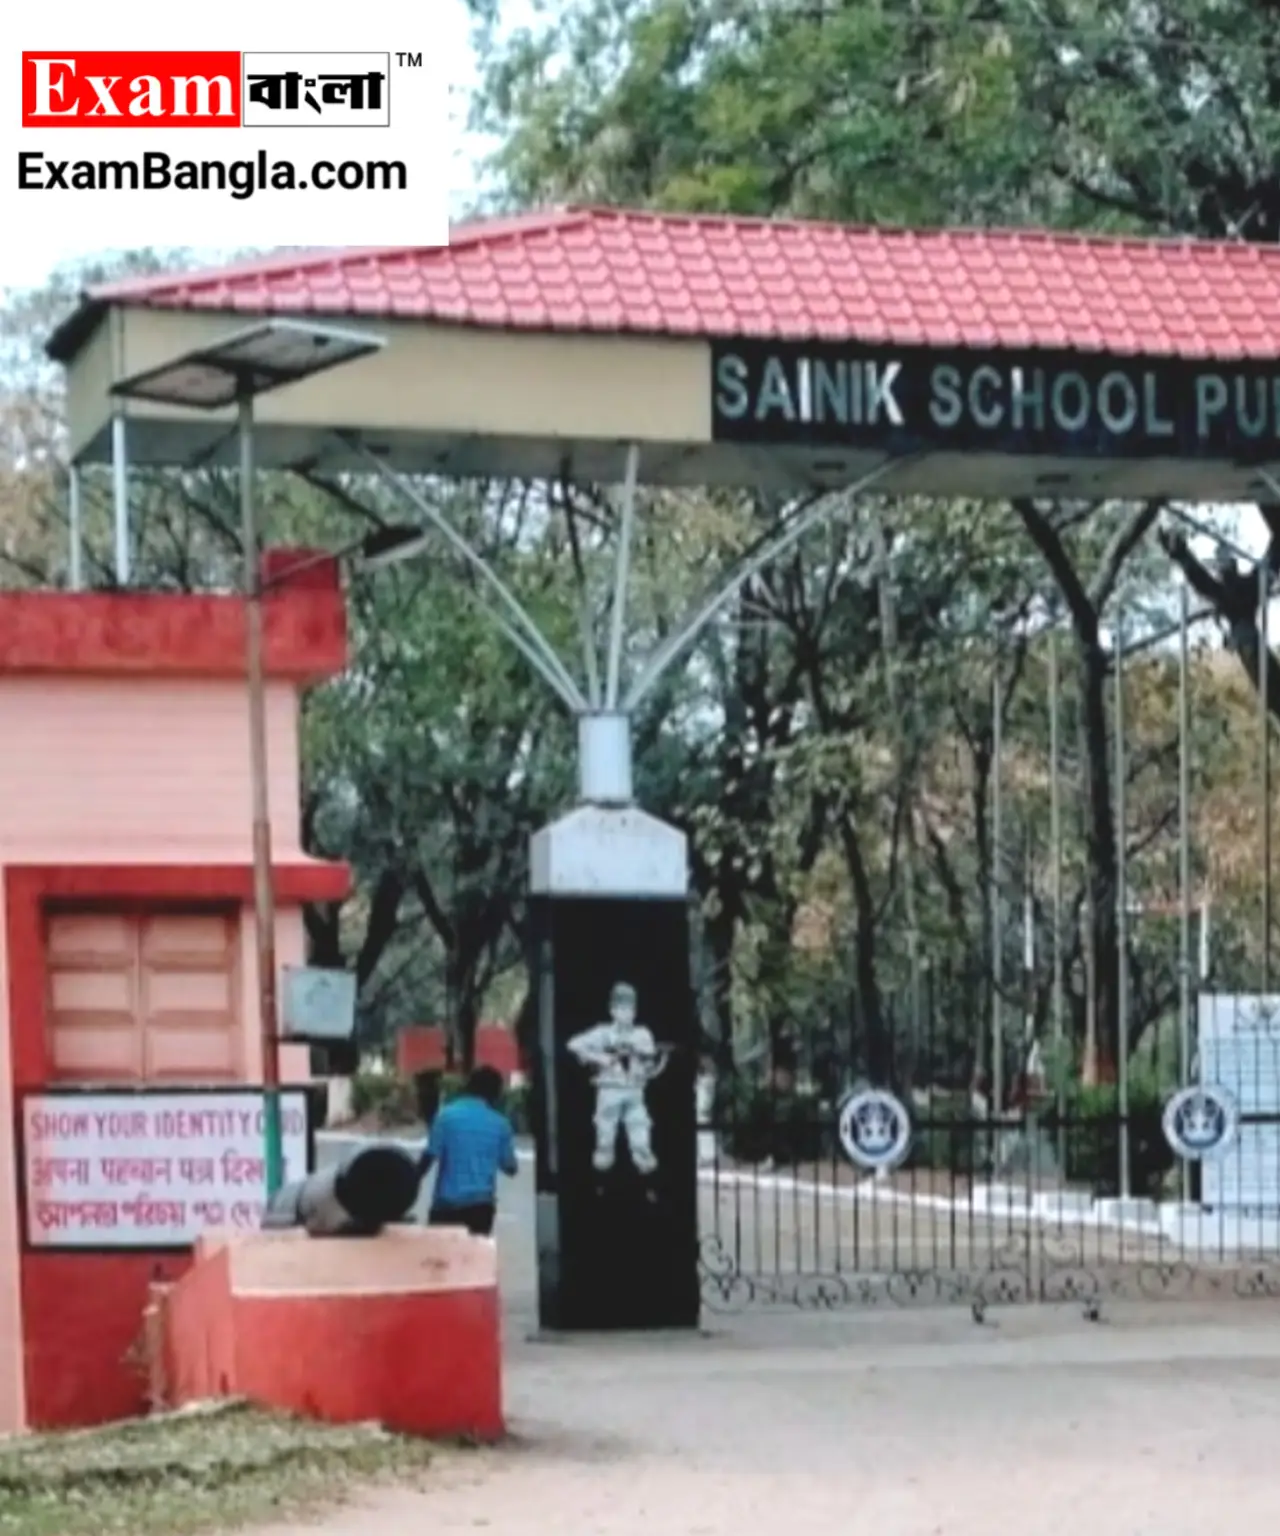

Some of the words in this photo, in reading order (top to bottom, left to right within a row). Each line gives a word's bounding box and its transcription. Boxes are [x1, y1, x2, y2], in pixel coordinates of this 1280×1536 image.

[716, 354, 904, 426] SAINIK
[928, 364, 1174, 437] SCHOOL
[30, 1108, 88, 1141] SHOW
[94, 1109, 148, 1141] YOUR
[154, 1107, 251, 1140] IDENTITY
